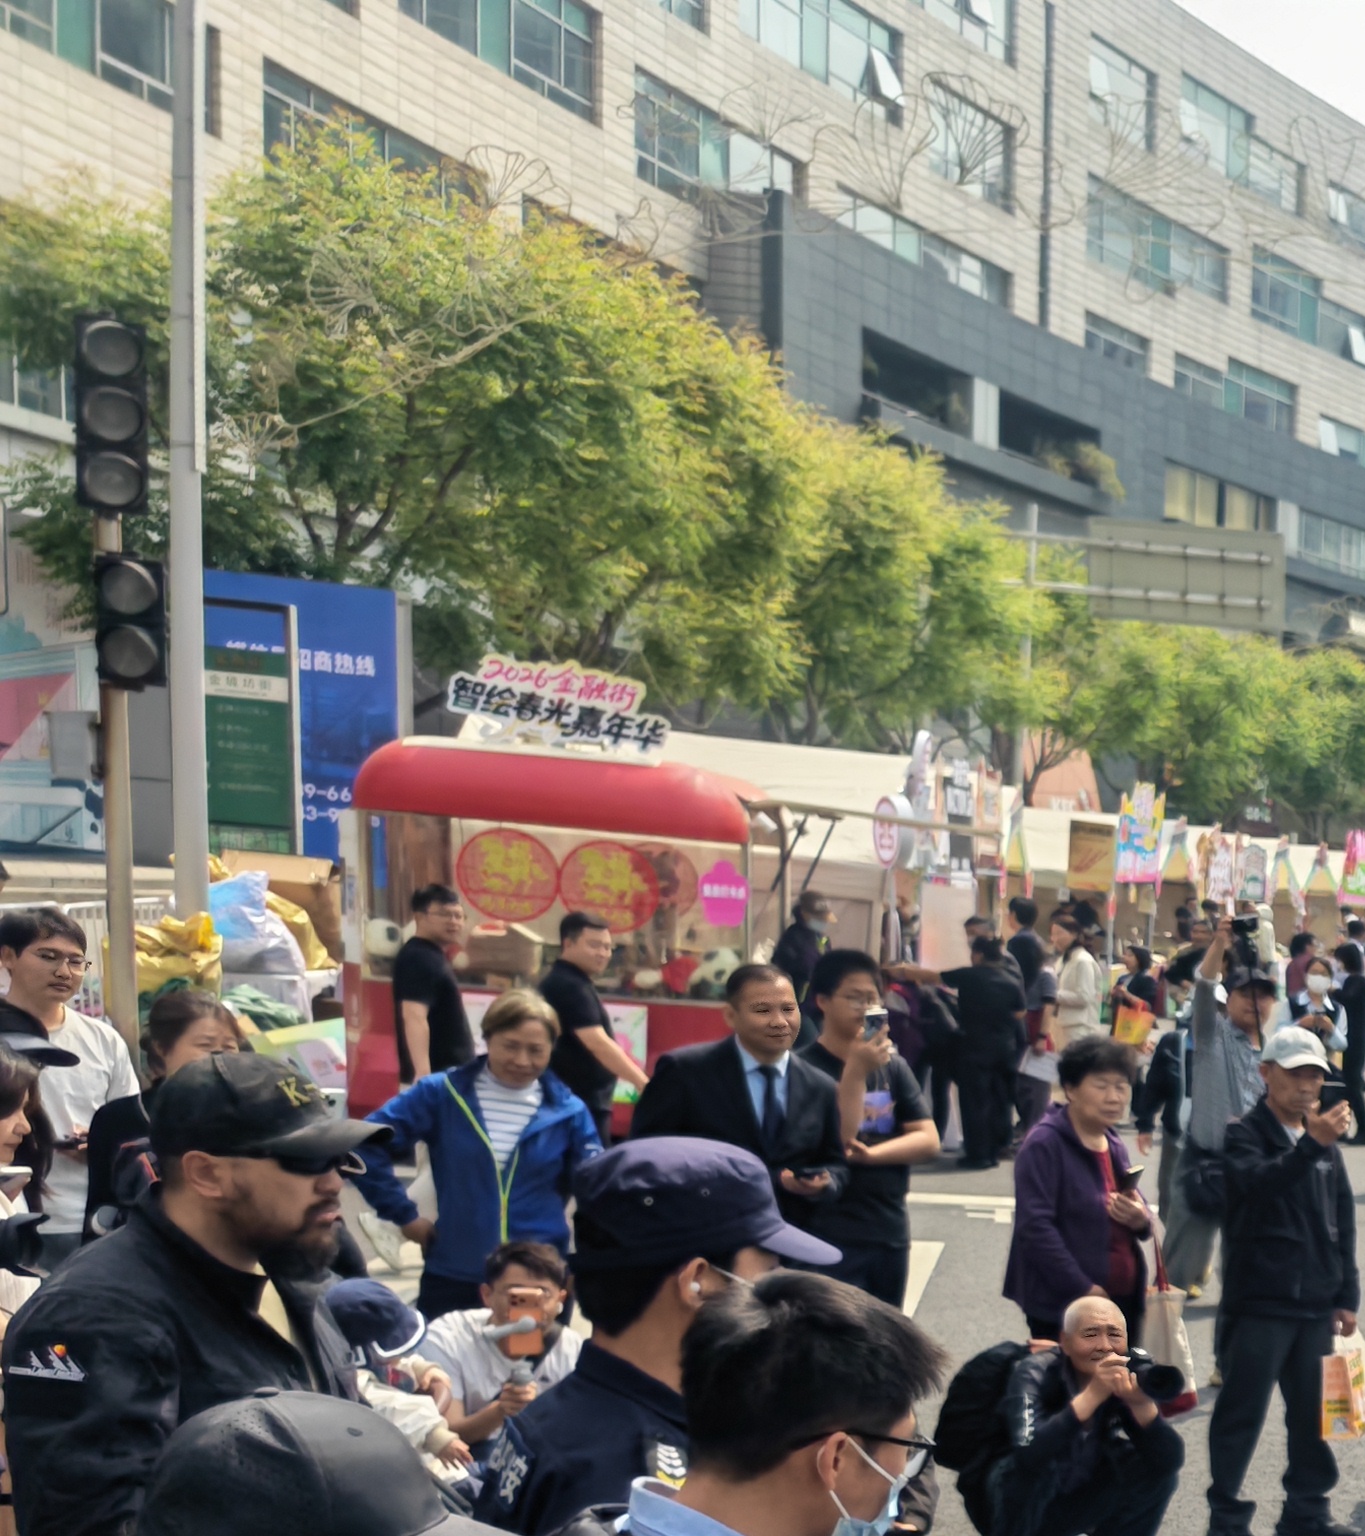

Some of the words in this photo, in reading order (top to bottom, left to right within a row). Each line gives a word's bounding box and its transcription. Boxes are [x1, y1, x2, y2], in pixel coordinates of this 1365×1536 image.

[452, 676, 667, 750] 智绘春光嘉年华
